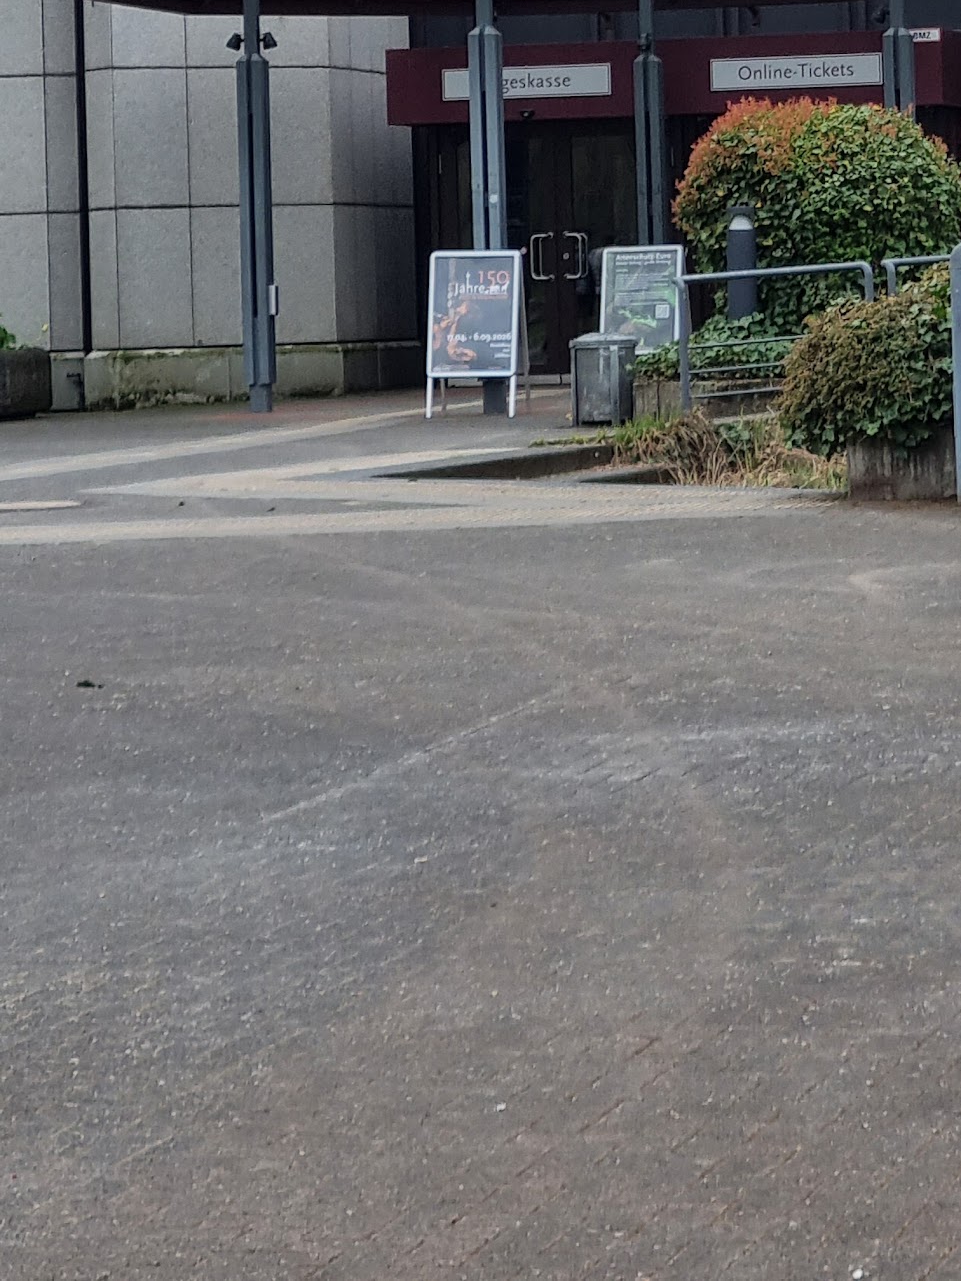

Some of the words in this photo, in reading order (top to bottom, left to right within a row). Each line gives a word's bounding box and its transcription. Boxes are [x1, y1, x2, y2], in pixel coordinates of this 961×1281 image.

[738, 61, 855, 81] Online-Tickets
[502, 72, 571, 94] geskasse
[454, 271, 486, 297] Jahre
[478, 270, 511, 287] 150
